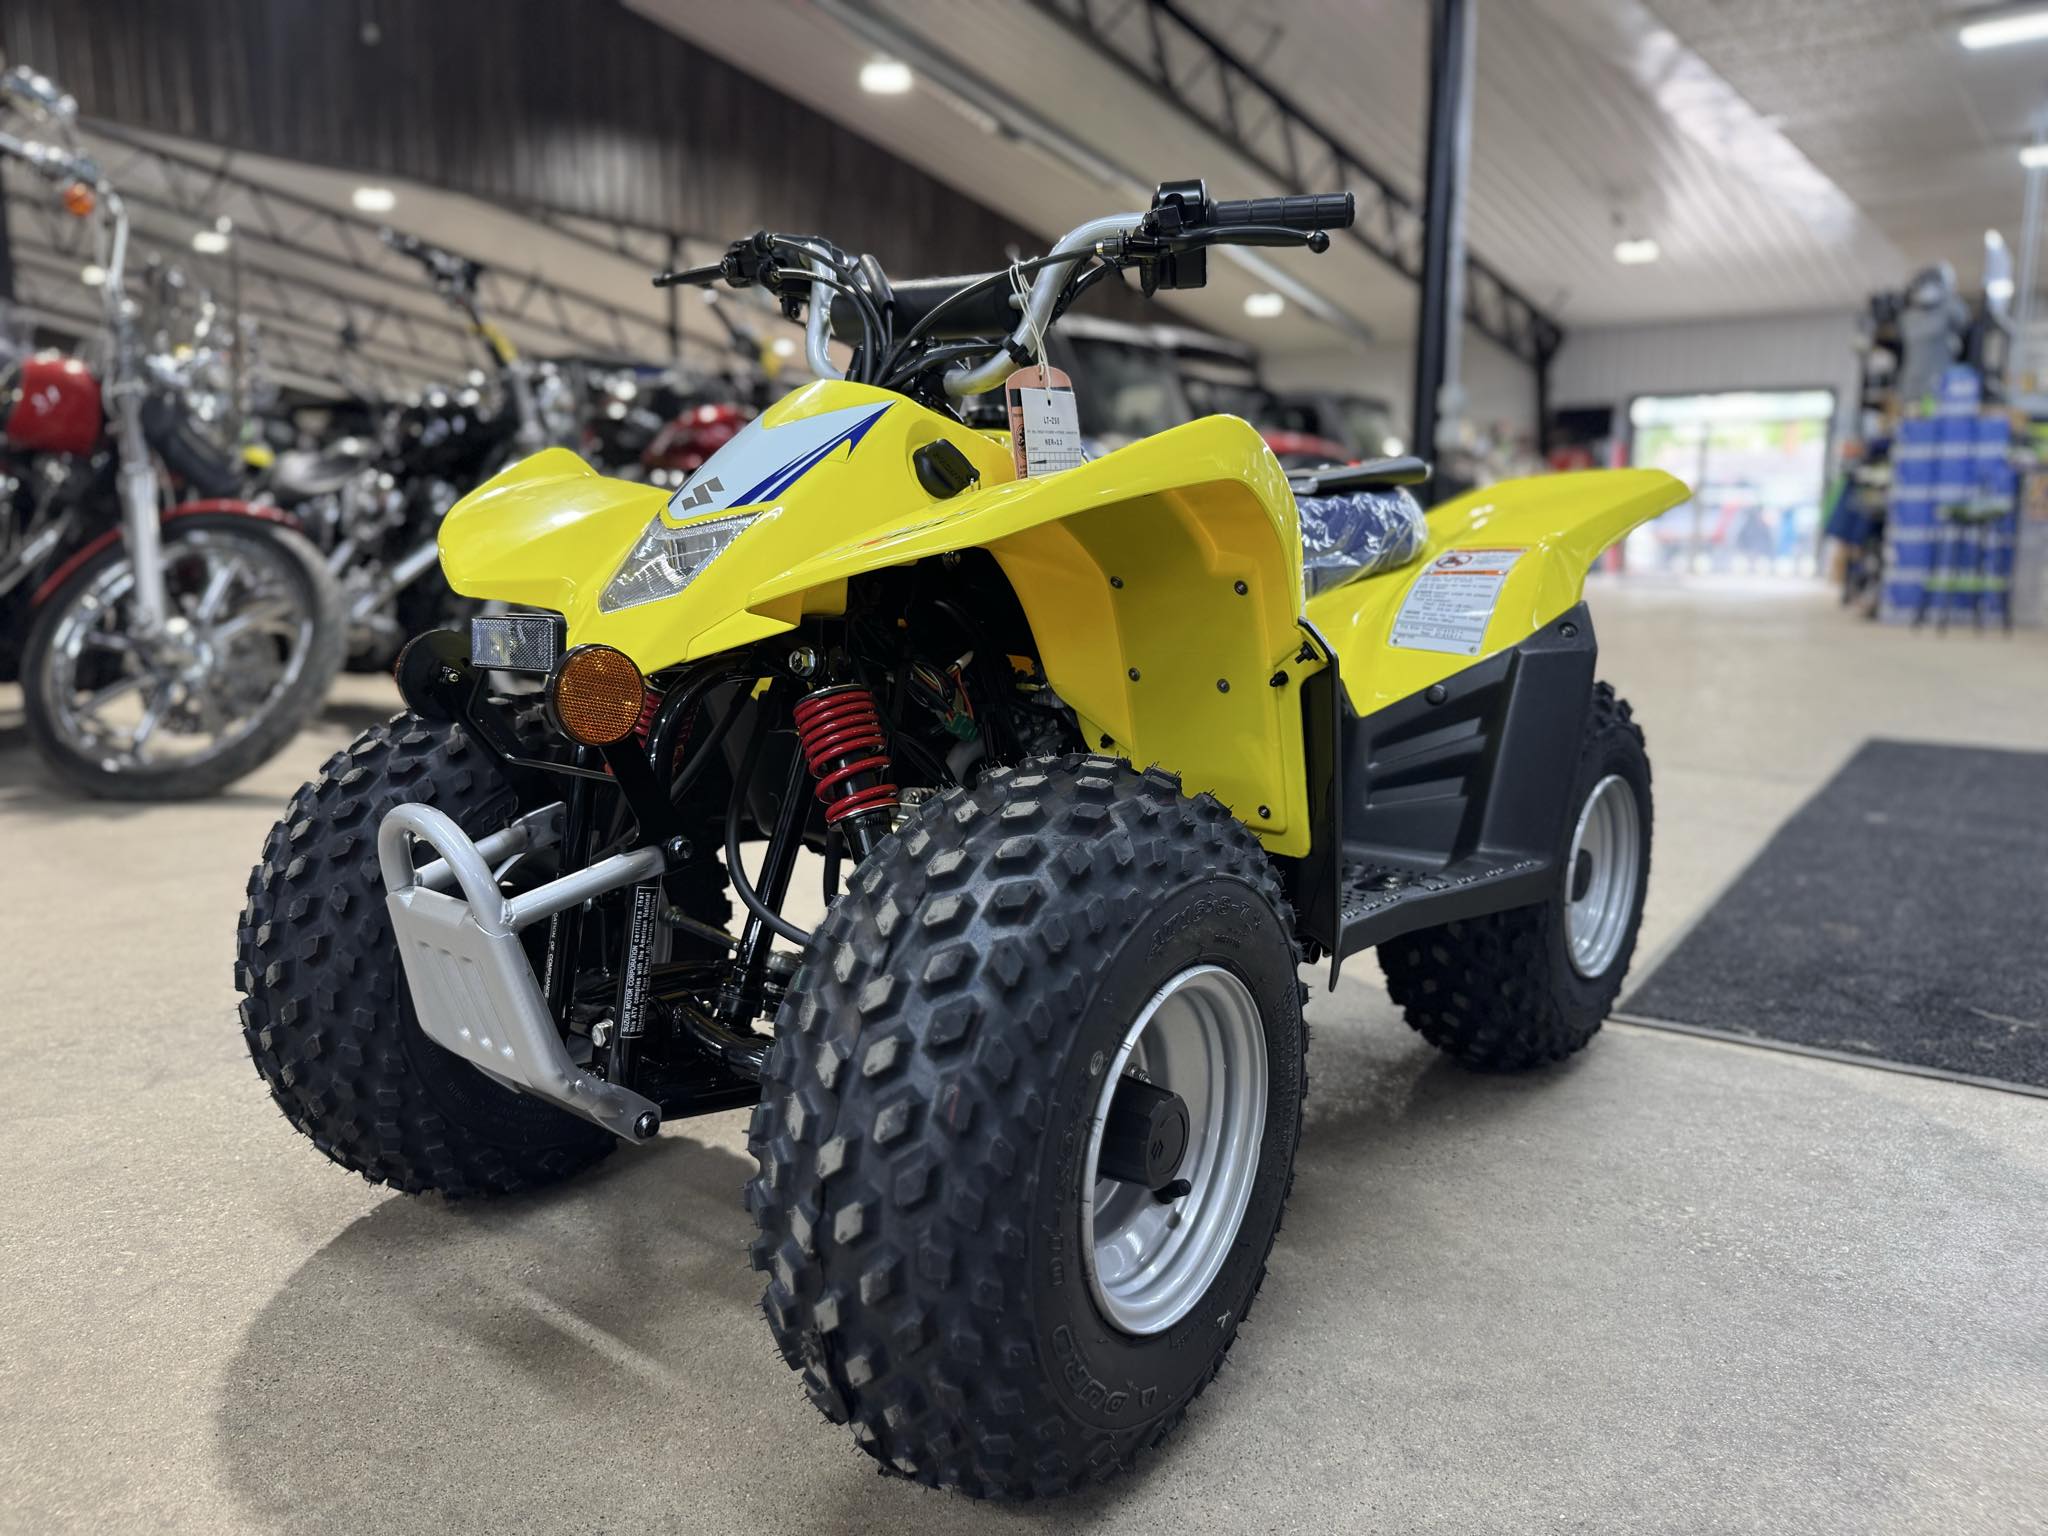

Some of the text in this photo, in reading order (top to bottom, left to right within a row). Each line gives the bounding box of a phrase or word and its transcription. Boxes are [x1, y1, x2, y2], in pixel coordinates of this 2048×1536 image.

[642, 892, 652, 918] National
[551, 912, 559, 938] CATION
[639, 920, 649, 949] American
[622, 892, 645, 1033] SUZUKI MOTOR CORPORATION certifies that
[638, 950, 646, 960] the
[544, 953, 554, 998] COMPLIANCE
[636, 962, 644, 975] with
[633, 977, 642, 1004] complies
[631, 1006, 639, 1019] ATV
